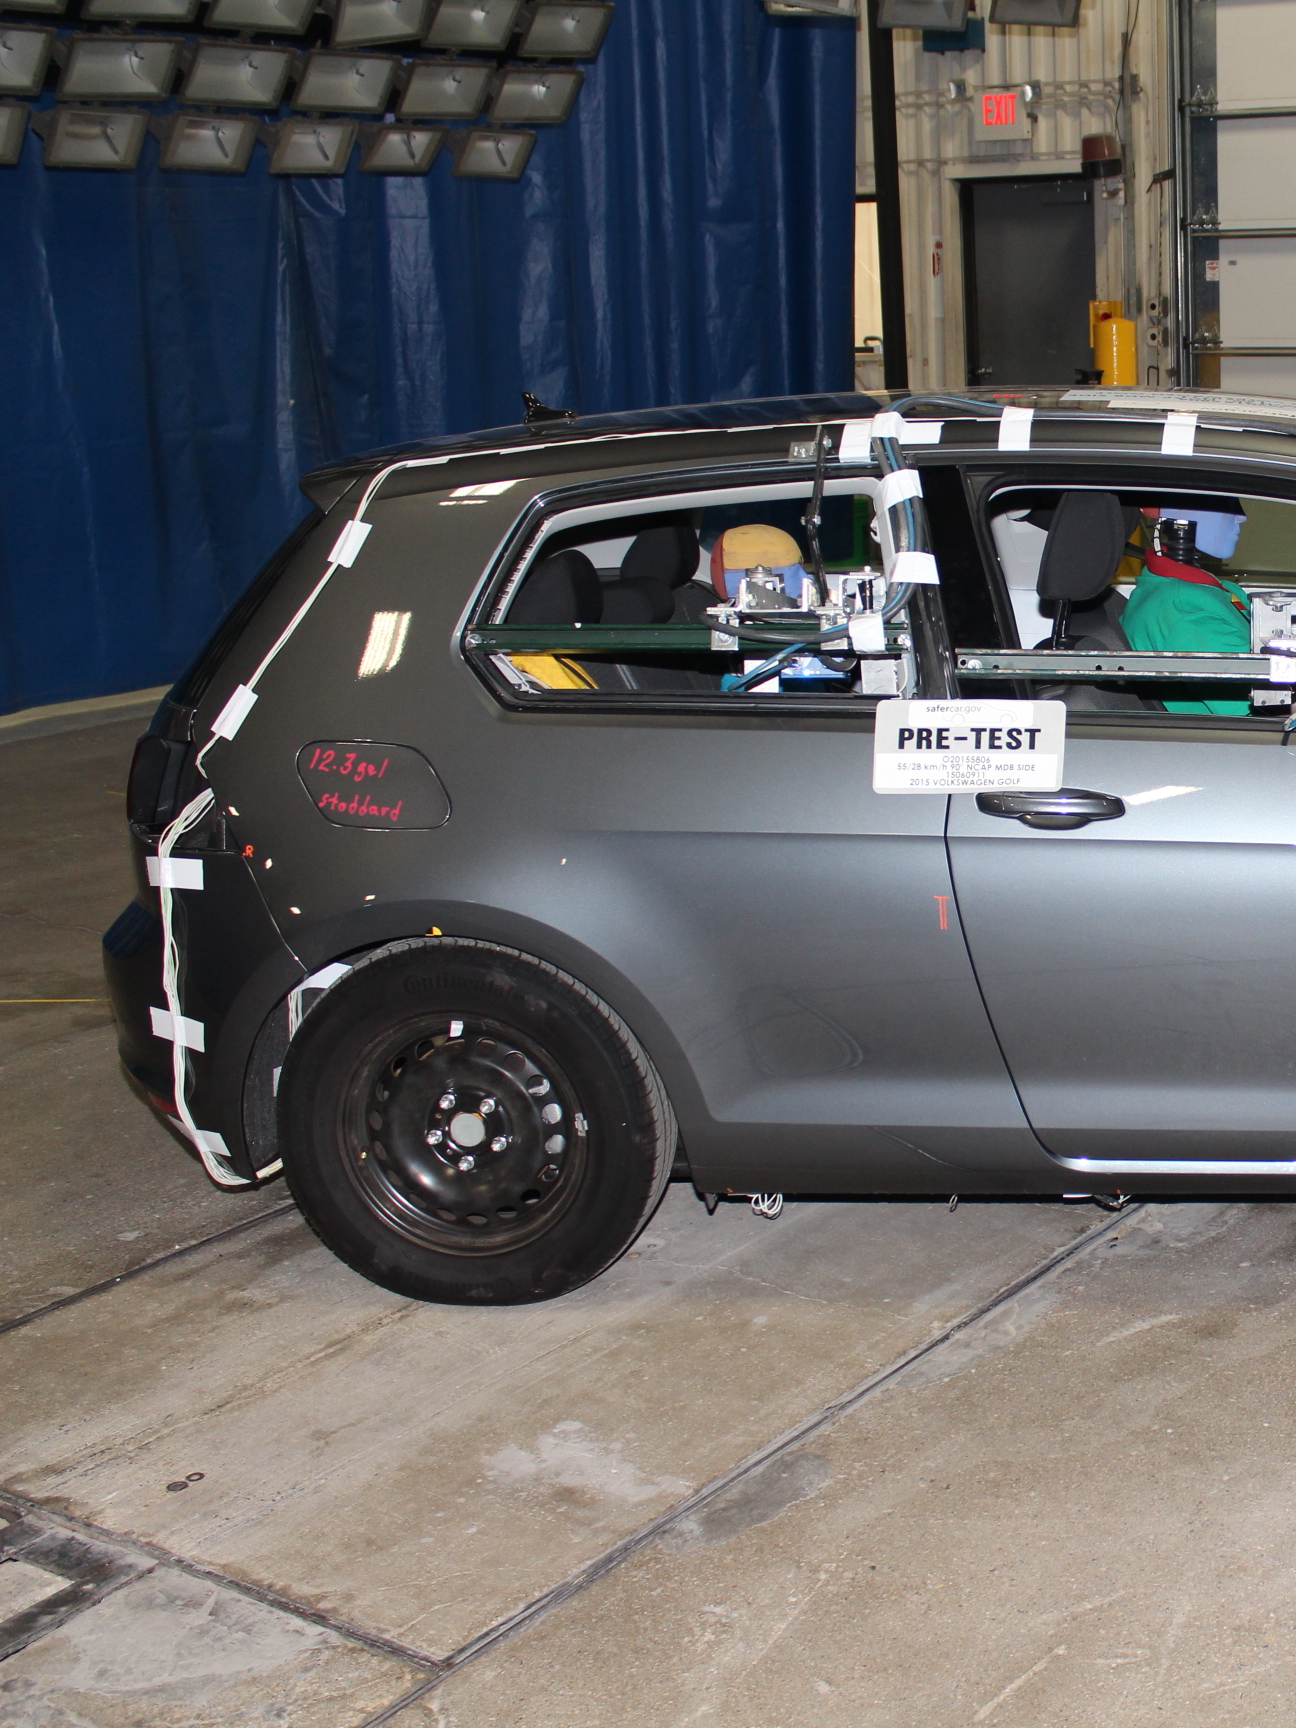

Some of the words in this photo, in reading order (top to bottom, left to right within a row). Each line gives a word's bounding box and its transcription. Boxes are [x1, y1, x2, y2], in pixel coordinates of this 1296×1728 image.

[982, 93, 1018, 126] EXIT
[926, 704, 982, 714] safercar.gov
[898, 727, 1042, 750] PRE-TEST
[897, 762, 922, 772] 55/28
[924, 763, 948, 772] km/h
[966, 763, 992, 771] NCAP
[994, 763, 1015, 771] MDB
[1017, 763, 1036, 772] SIDE
[946, 771, 985, 779] 15060911
[909, 778, 930, 786] 2015
[932, 778, 995, 787] VOLKSWAGEN
[997, 777, 1021, 786] GOLF
